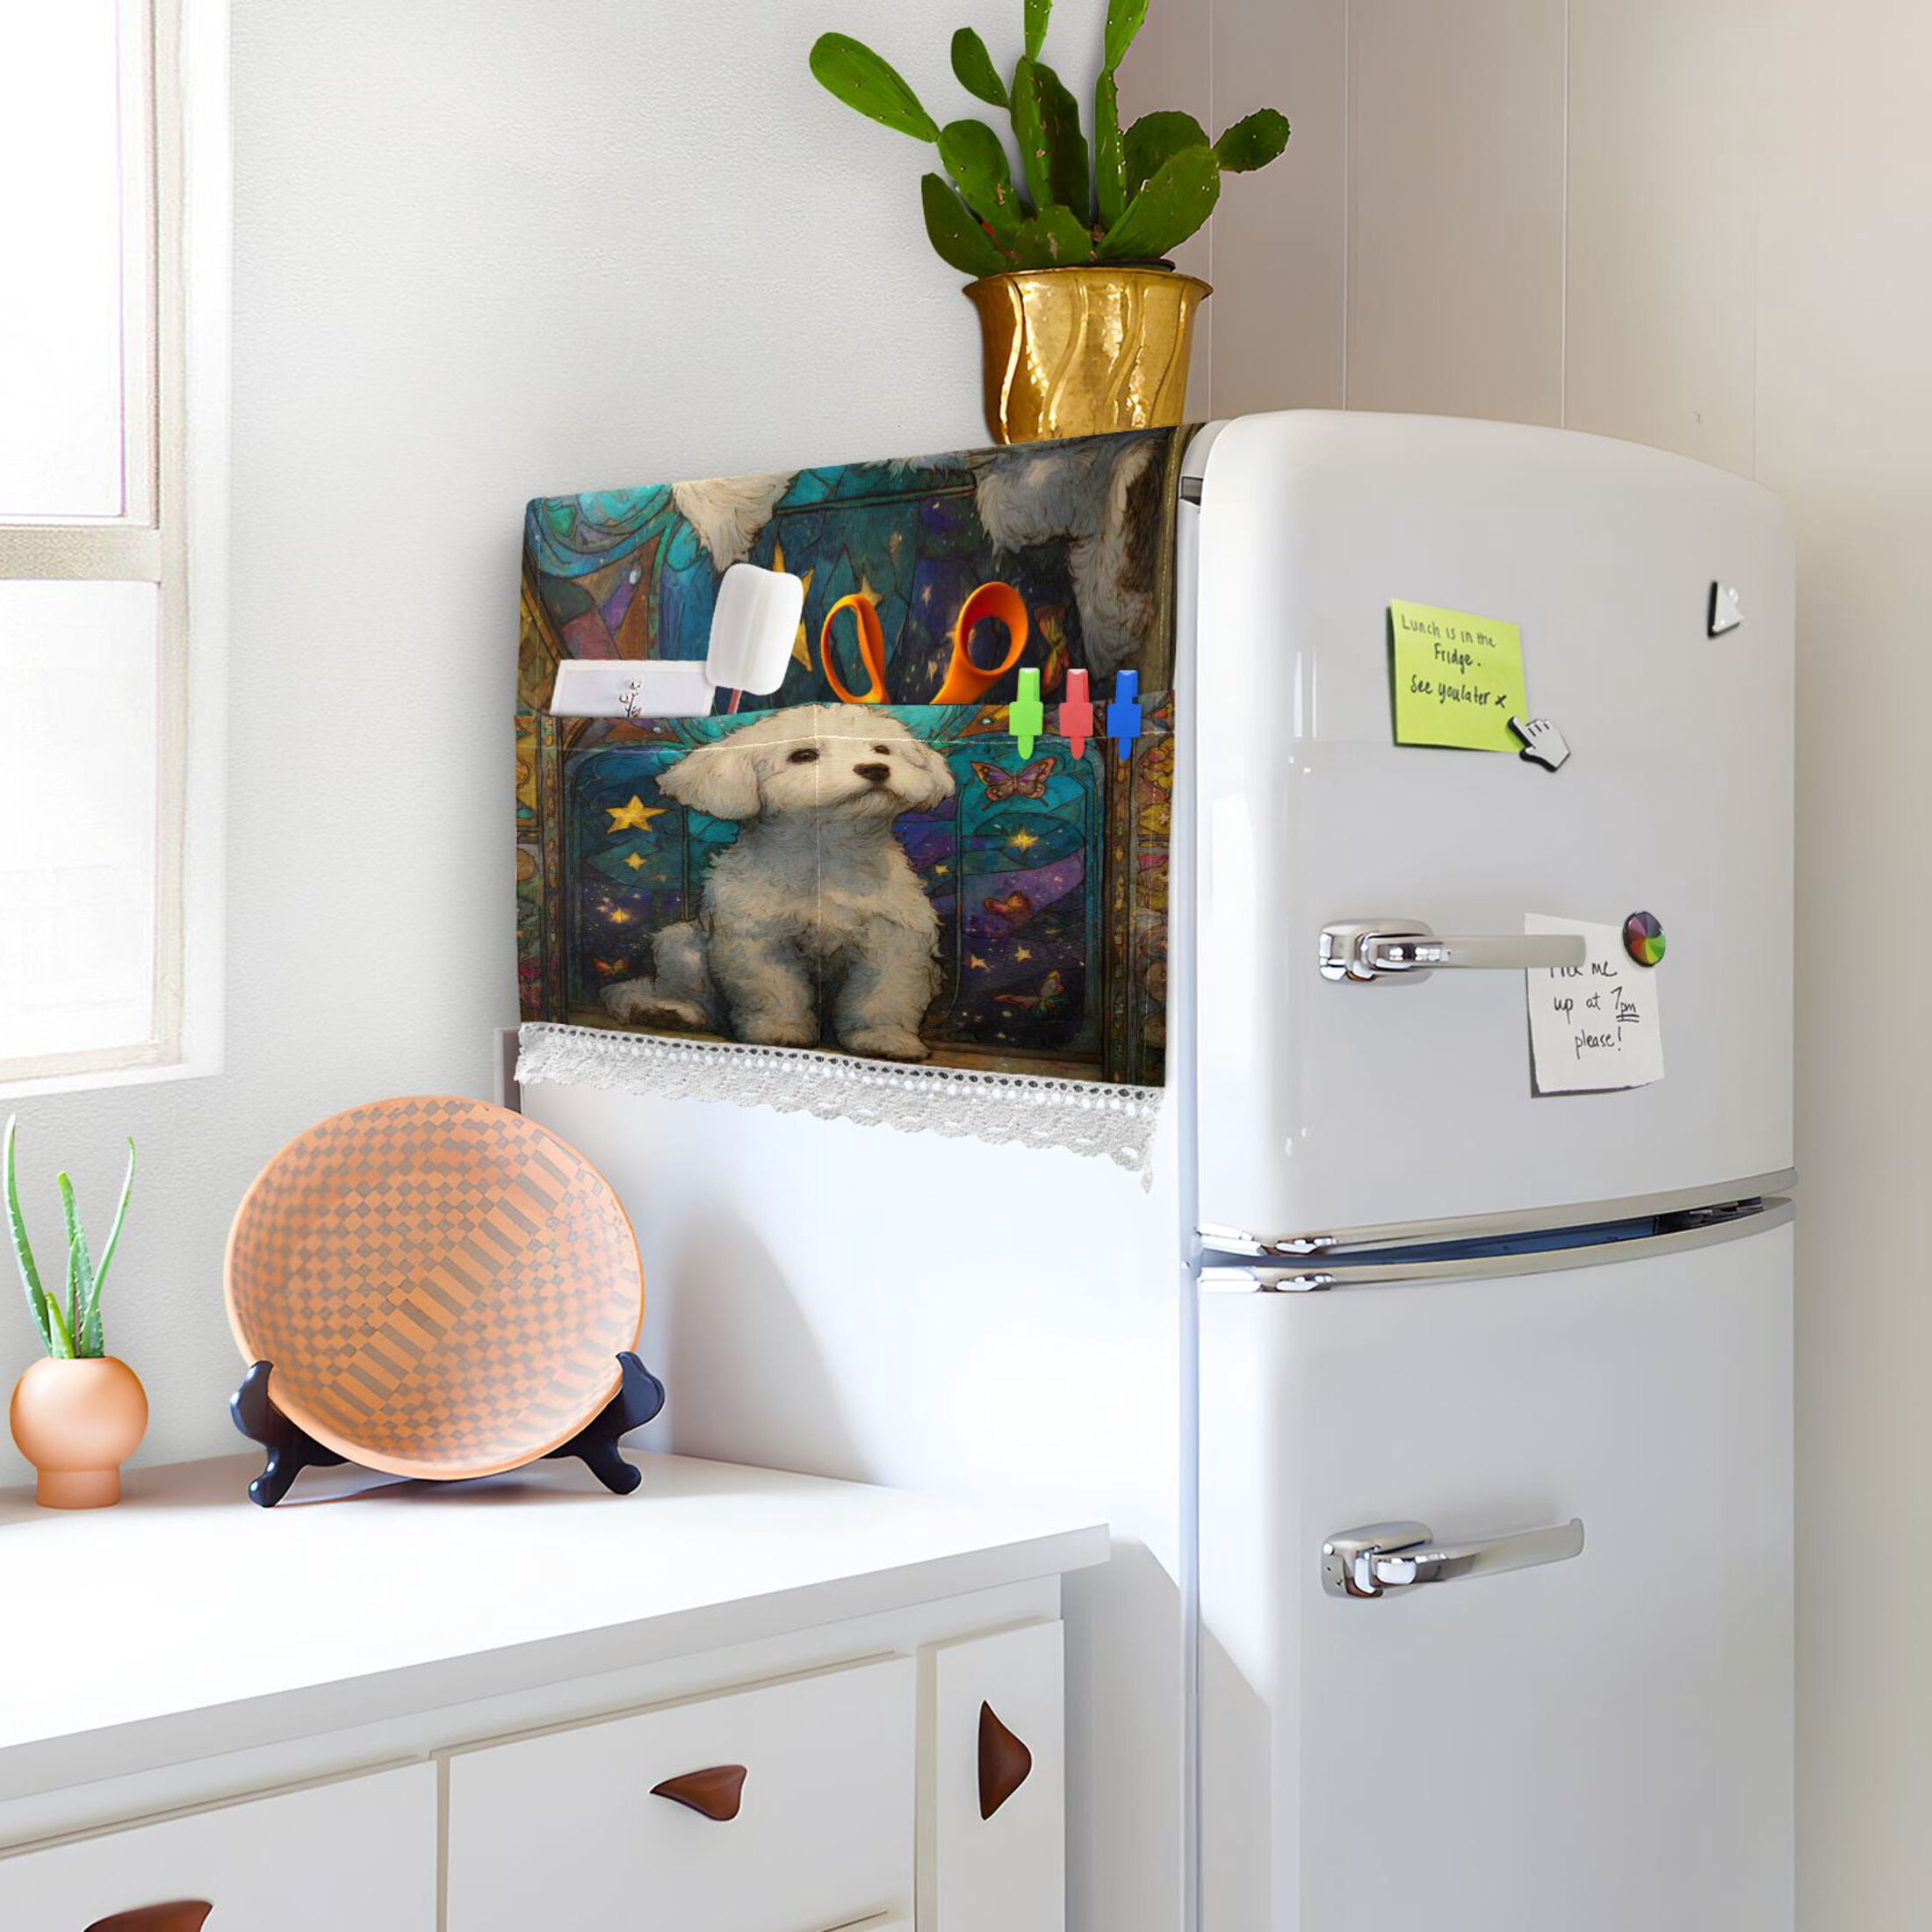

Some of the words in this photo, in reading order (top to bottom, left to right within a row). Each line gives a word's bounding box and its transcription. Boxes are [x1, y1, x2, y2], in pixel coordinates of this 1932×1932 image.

[1401, 614, 1440, 638] Lunch
[1445, 627, 1456, 640] is
[1460, 631, 1474, 644] in
[1477, 631, 1496, 647] the
[1410, 674, 1433, 694] See
[1554, 997, 1574, 1024] up
[1586, 992, 1601, 1010] at
[1575, 1026, 1622, 1060] please!
